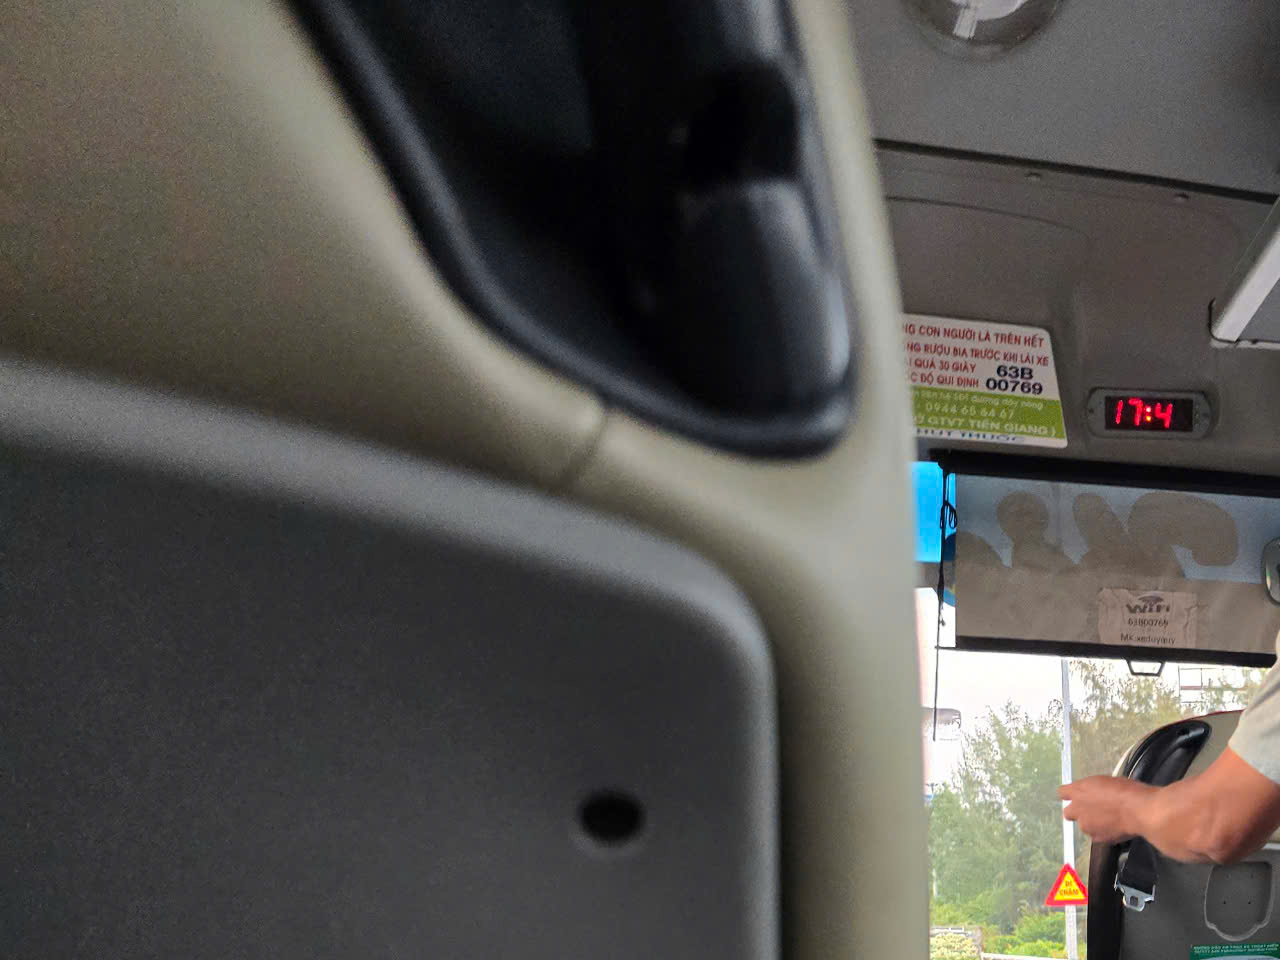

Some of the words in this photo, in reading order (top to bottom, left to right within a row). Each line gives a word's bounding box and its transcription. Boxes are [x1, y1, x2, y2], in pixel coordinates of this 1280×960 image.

[919, 324, 940, 338] CON
[944, 326, 976, 340] NGƯỜI
[994, 330, 1021, 345] TRÊN
[1024, 333, 1044, 348] HẾT
[924, 343, 950, 356] RƯỢU
[953, 346, 968, 358] BIA
[970, 347, 1001, 362] TRƯỚC
[1003, 352, 1018, 363] KHI
[1020, 353, 1034, 365] LÁI
[1037, 356, 1050, 366] XE
[914, 357, 936, 369] QUÁ
[940, 361, 950, 370] 30
[920, 371, 934, 386] ĐỘ
[937, 374, 954, 385] QUI
[957, 376, 980, 388] ĐỊNH
[996, 365, 1034, 380] 63B
[986, 378, 1043, 395] 00769
[1004, 422, 1049, 436] GIANG
